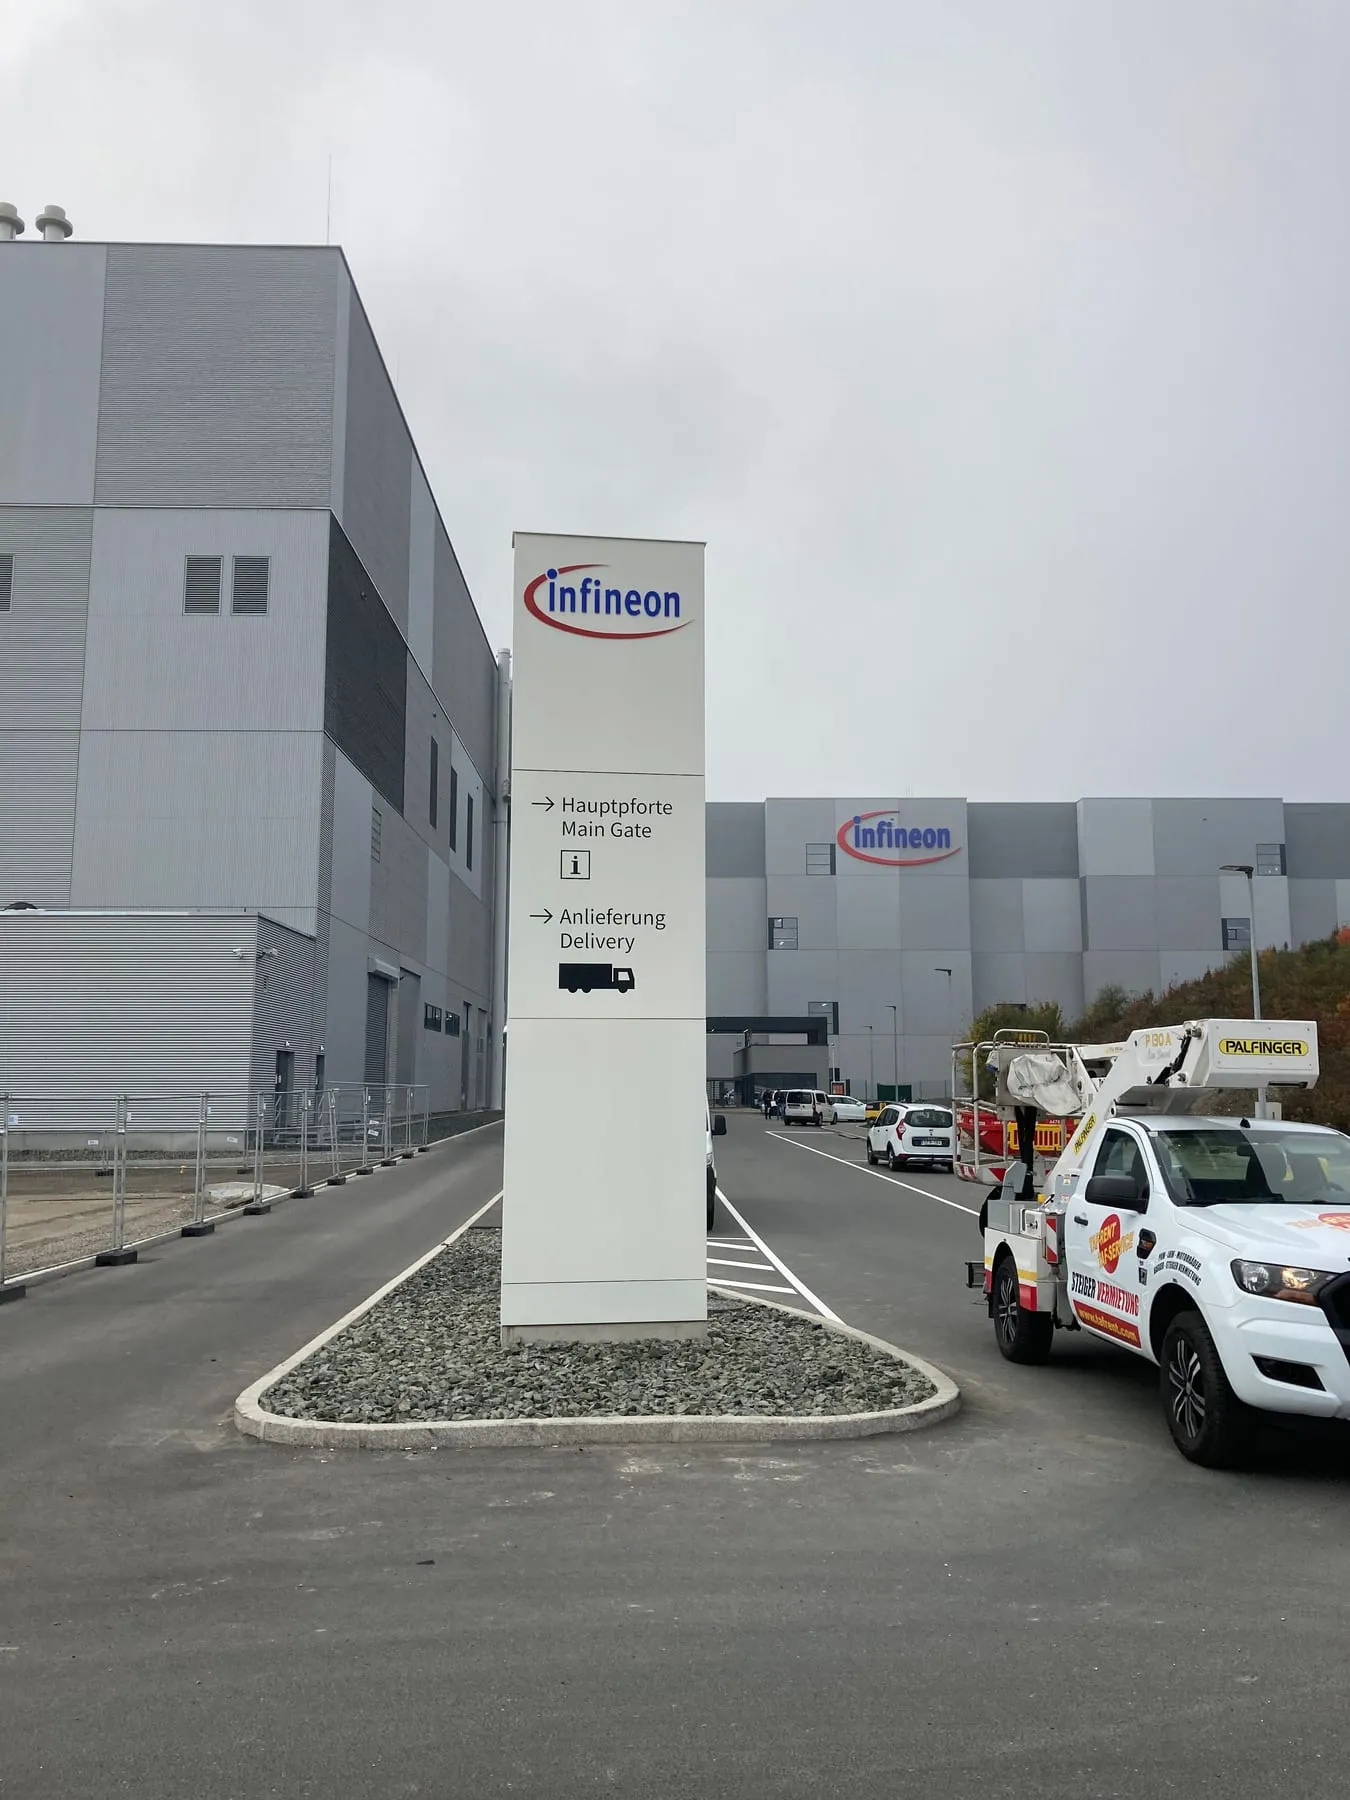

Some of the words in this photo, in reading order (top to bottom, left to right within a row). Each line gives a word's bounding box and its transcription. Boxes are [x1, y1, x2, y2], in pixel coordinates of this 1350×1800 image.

[547, 568, 680, 618] infineon
[562, 797, 673, 818] Hauptpforte
[562, 821, 605, 837] Main
[610, 822, 652, 838] Gate
[853, 815, 951, 849] infineon
[560, 908, 666, 930] Anlieferung
[560, 932, 635, 954] Delivery
[1225, 1040, 1303, 1055] PALFINGER
[1071, 1271, 1097, 1299] STEIGER
[1097, 1280, 1140, 1317] VERMIETUNG
